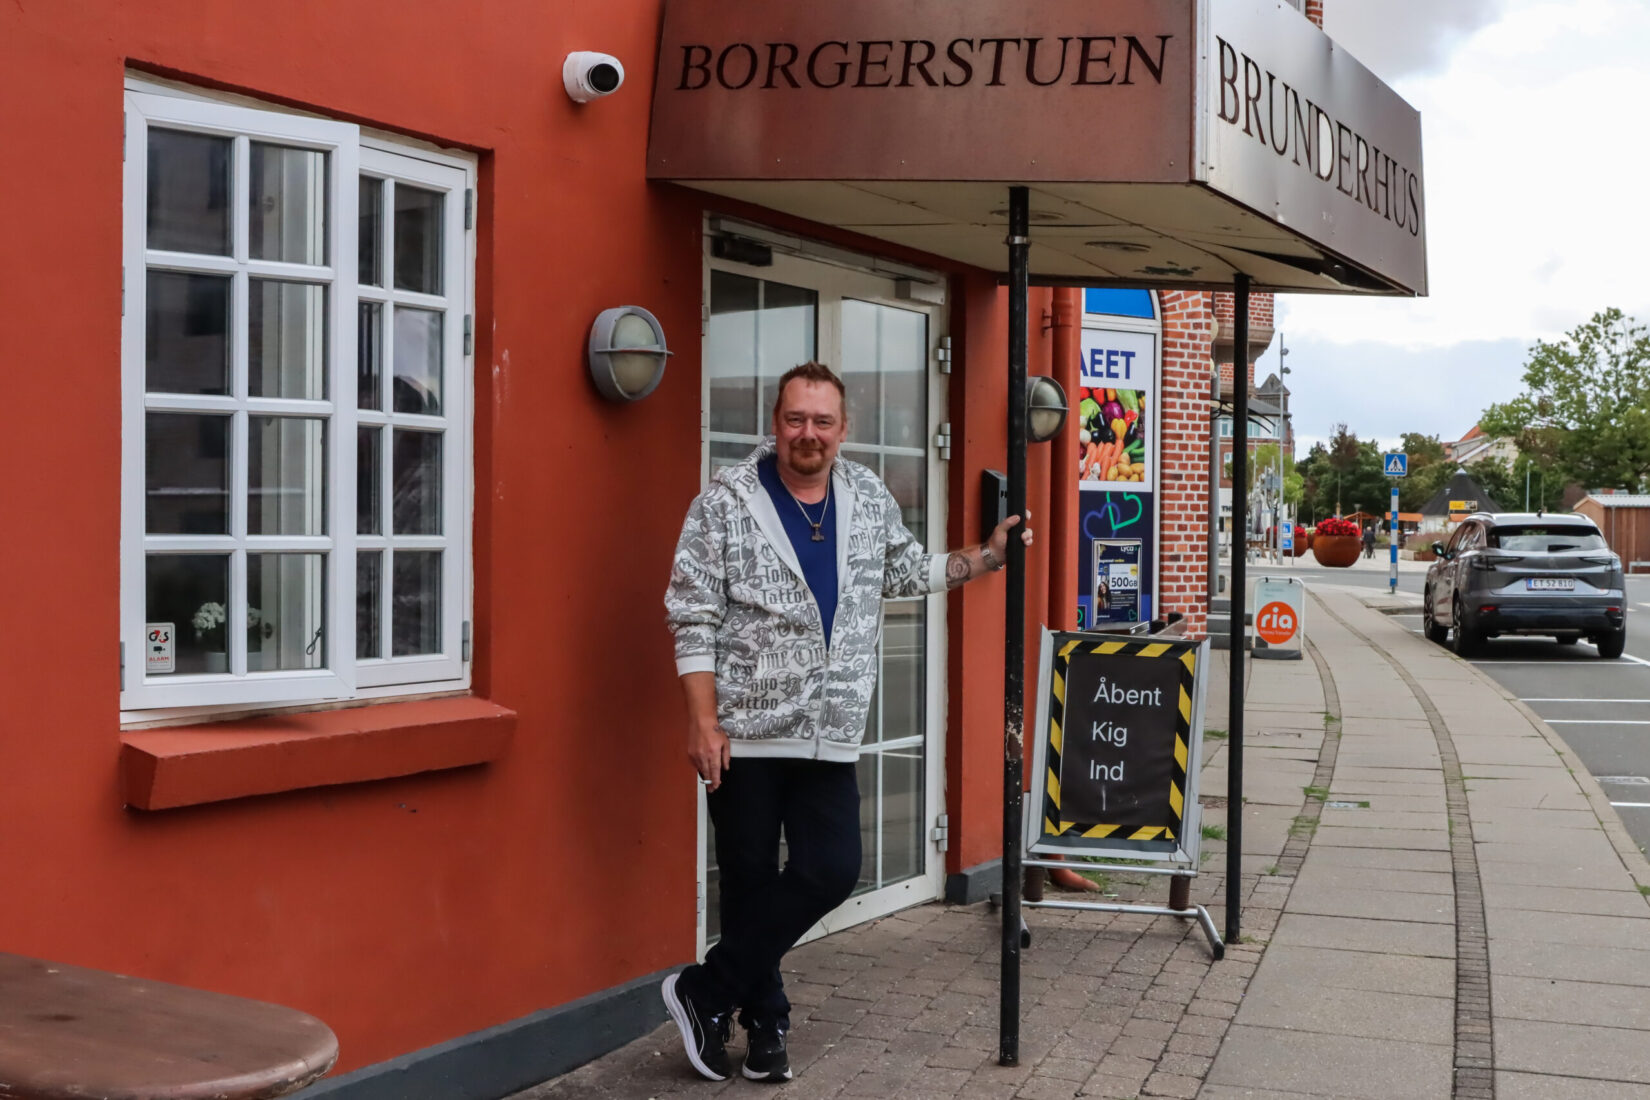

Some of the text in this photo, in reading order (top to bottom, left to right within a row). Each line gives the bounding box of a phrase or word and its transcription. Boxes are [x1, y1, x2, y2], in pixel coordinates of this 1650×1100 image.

[674, 35, 1174, 90] BORGERSTUEN
[1216, 35, 1419, 236] BRUNDERHUS
[1261, 607, 1293, 629] ria
[1093, 676, 1162, 706] Åbent
[1092, 721, 1128, 747] Kig
[1089, 759, 1125, 781] Ind
